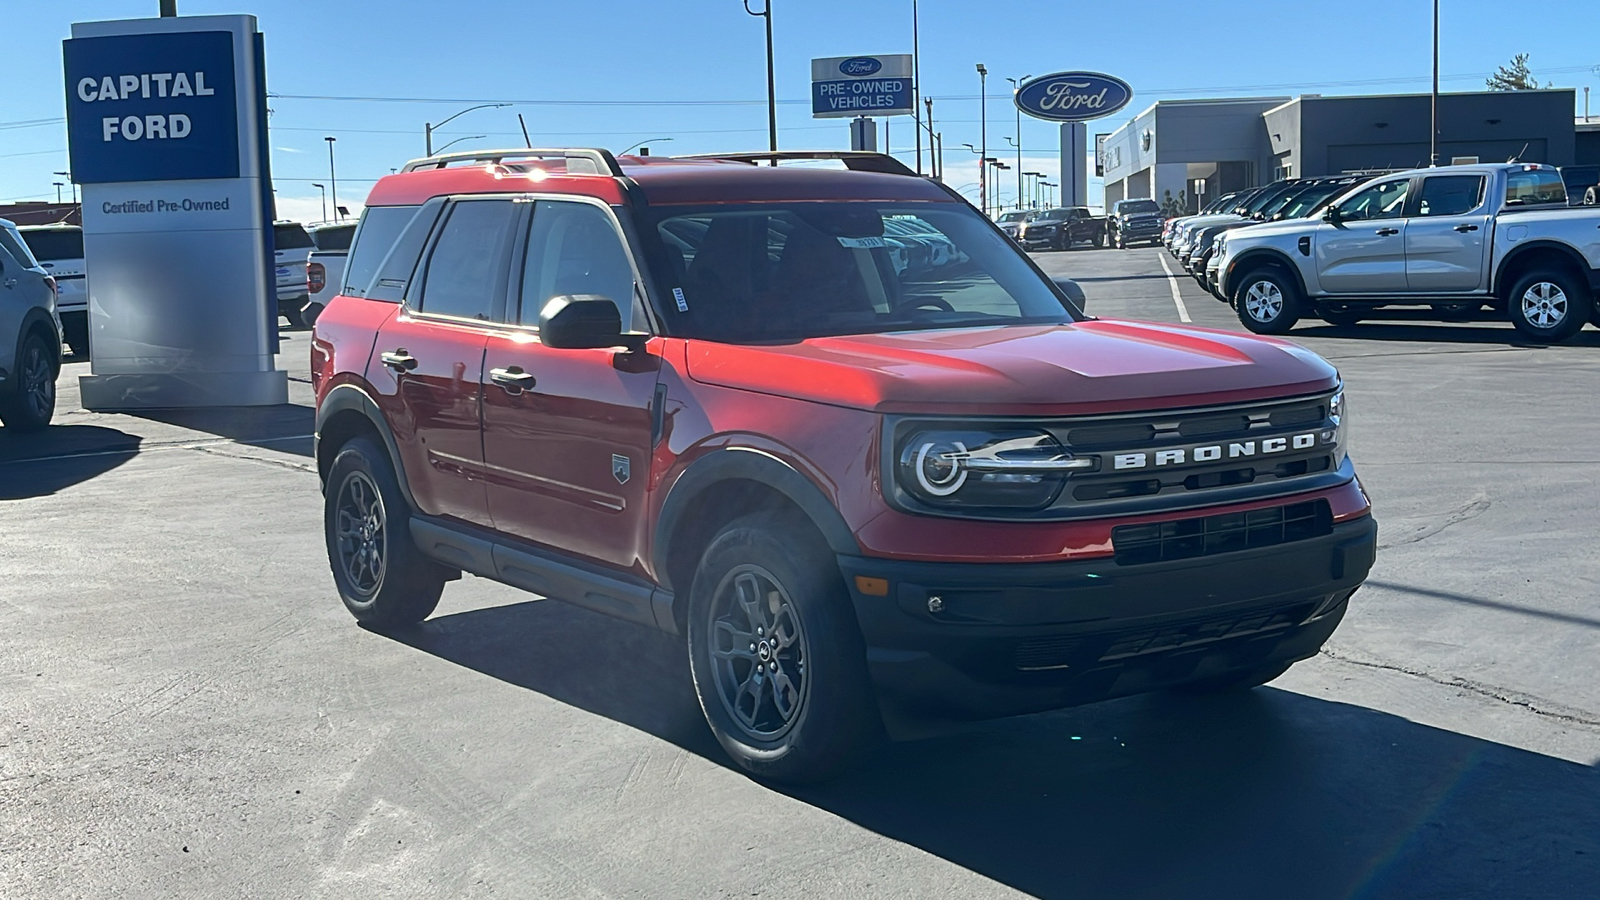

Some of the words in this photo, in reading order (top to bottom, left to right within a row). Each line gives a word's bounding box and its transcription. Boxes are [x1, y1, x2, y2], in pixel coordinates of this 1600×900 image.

[847, 61, 873, 73] Ford
[77, 72, 215, 103] CAPITAL
[828, 94, 895, 109] VEHICLES
[1039, 82, 1108, 110] Ford
[102, 113, 192, 142] FORD
[102, 200, 154, 214] Certified
[157, 197, 230, 213] Pre-Owned
[1114, 433, 1315, 470] BRONCO
